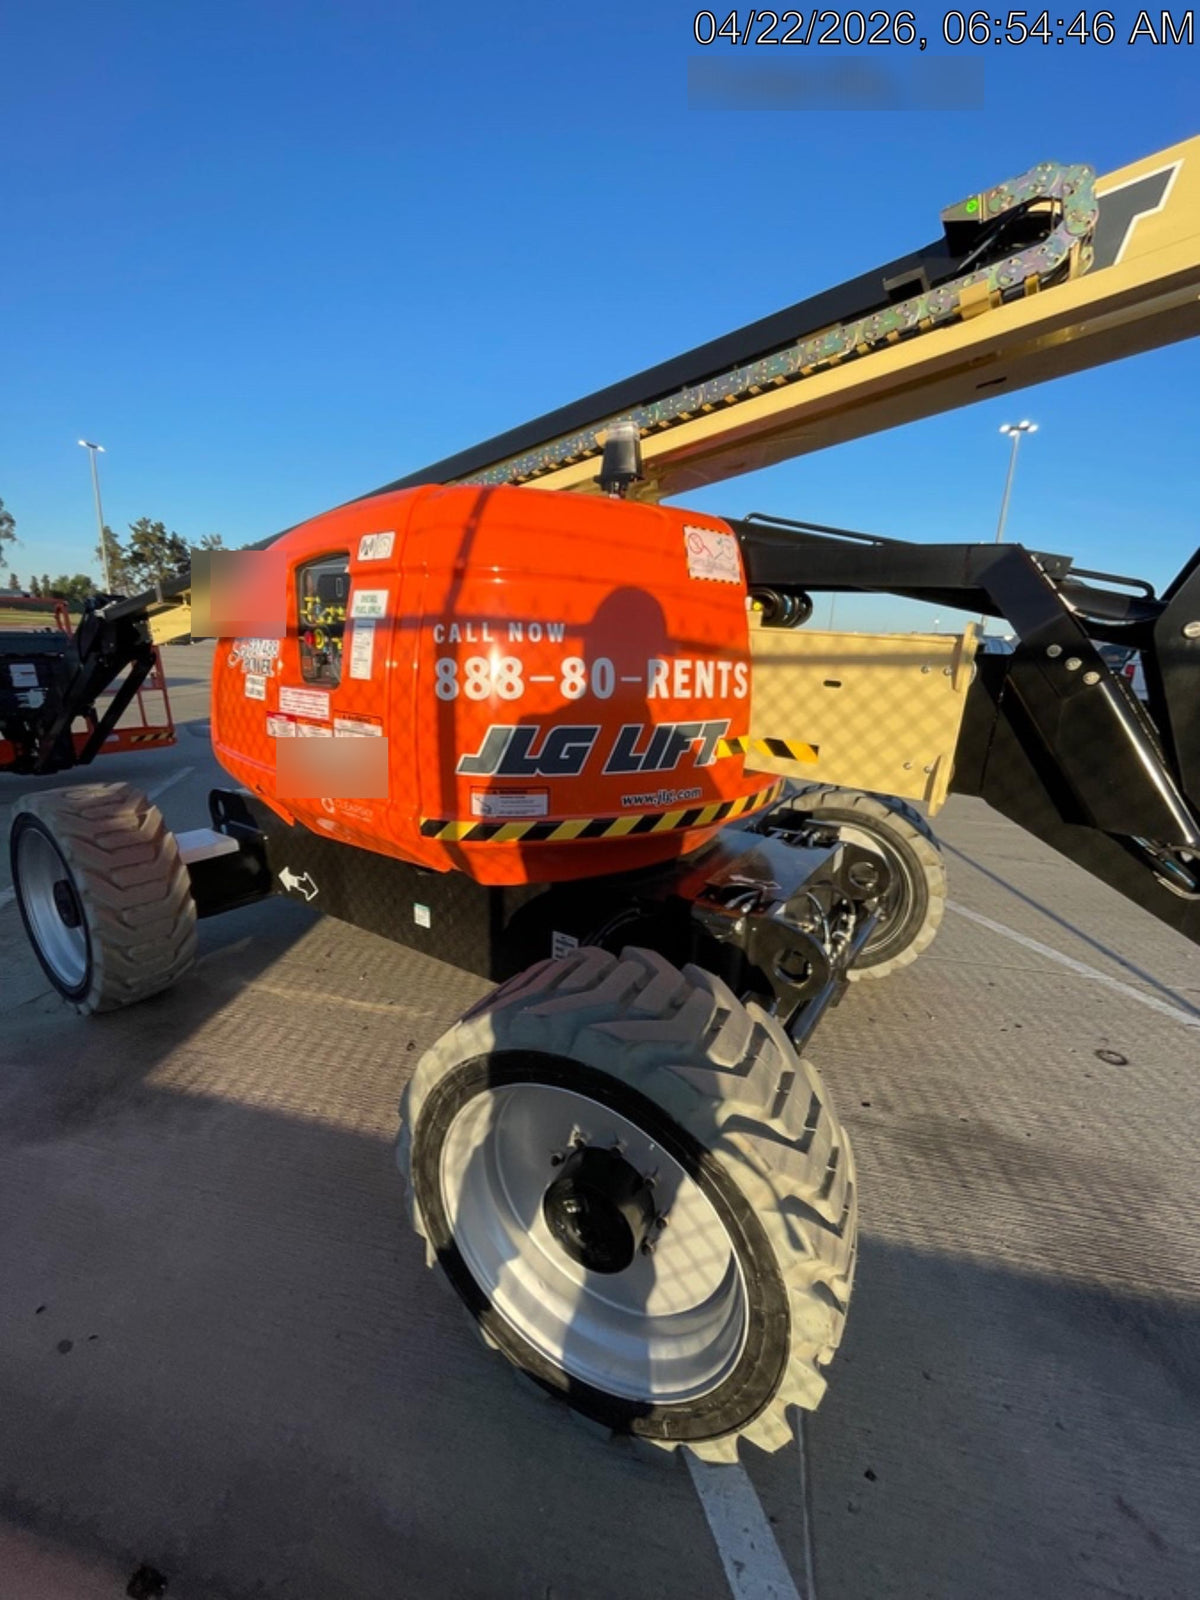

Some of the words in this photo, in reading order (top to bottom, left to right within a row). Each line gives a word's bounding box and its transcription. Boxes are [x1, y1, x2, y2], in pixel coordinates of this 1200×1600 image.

[433, 622, 494, 643] CALL
[508, 621, 566, 643] NOW
[434, 656, 749, 702] 888-80-RENTS
[455, 723, 602, 778] JLG
[602, 718, 732, 776] LIFT
[620, 787, 703, 808] www.jlg.com
